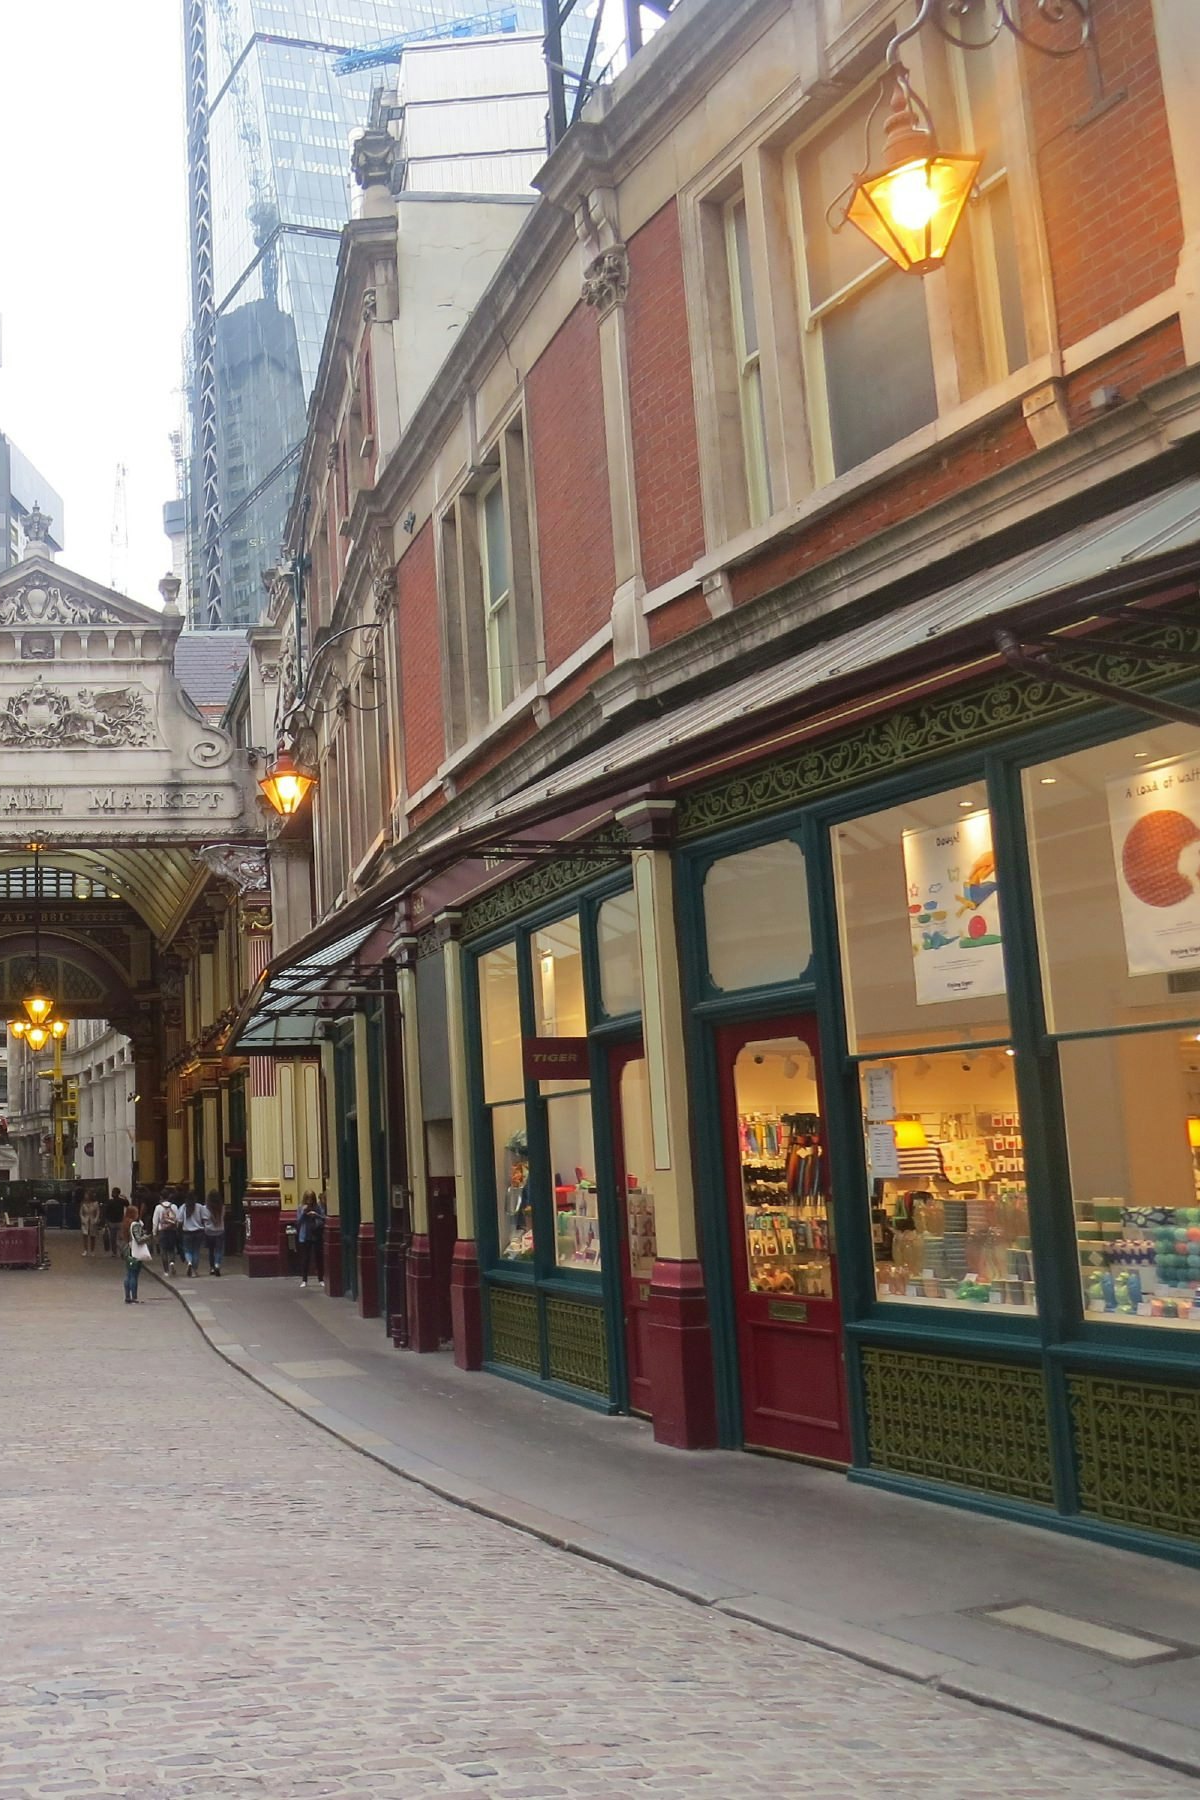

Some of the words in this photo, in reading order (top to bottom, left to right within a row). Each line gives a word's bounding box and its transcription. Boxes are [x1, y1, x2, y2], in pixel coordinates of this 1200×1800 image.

[87, 788, 224, 810] MARKET
[532, 1053, 577, 1063] TIGER
[284, 1194, 293, 1204] H
